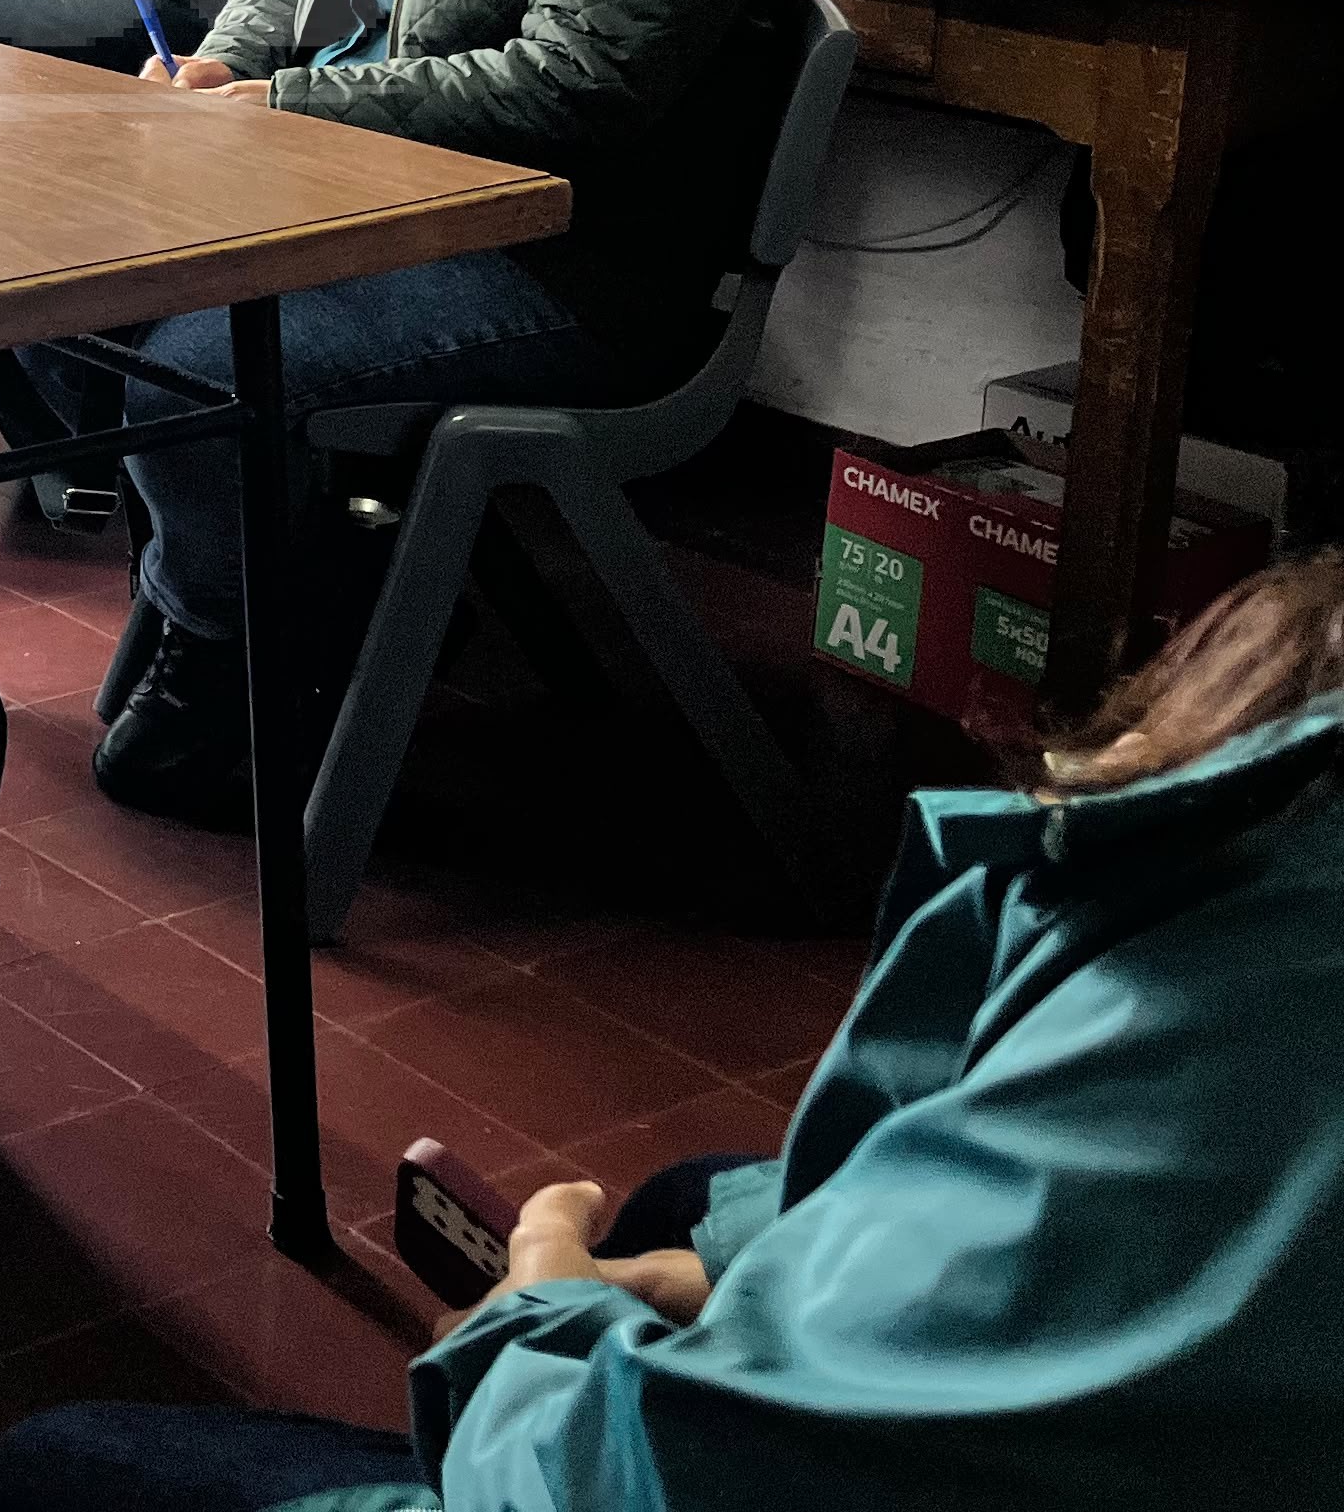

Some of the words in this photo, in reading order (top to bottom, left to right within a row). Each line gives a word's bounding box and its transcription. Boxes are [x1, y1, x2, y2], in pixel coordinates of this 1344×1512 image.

[843, 466, 940, 521] CHAMEX
[840, 537, 865, 565] 75
[875, 552, 904, 581] 20
[827, 603, 902, 674] A4
